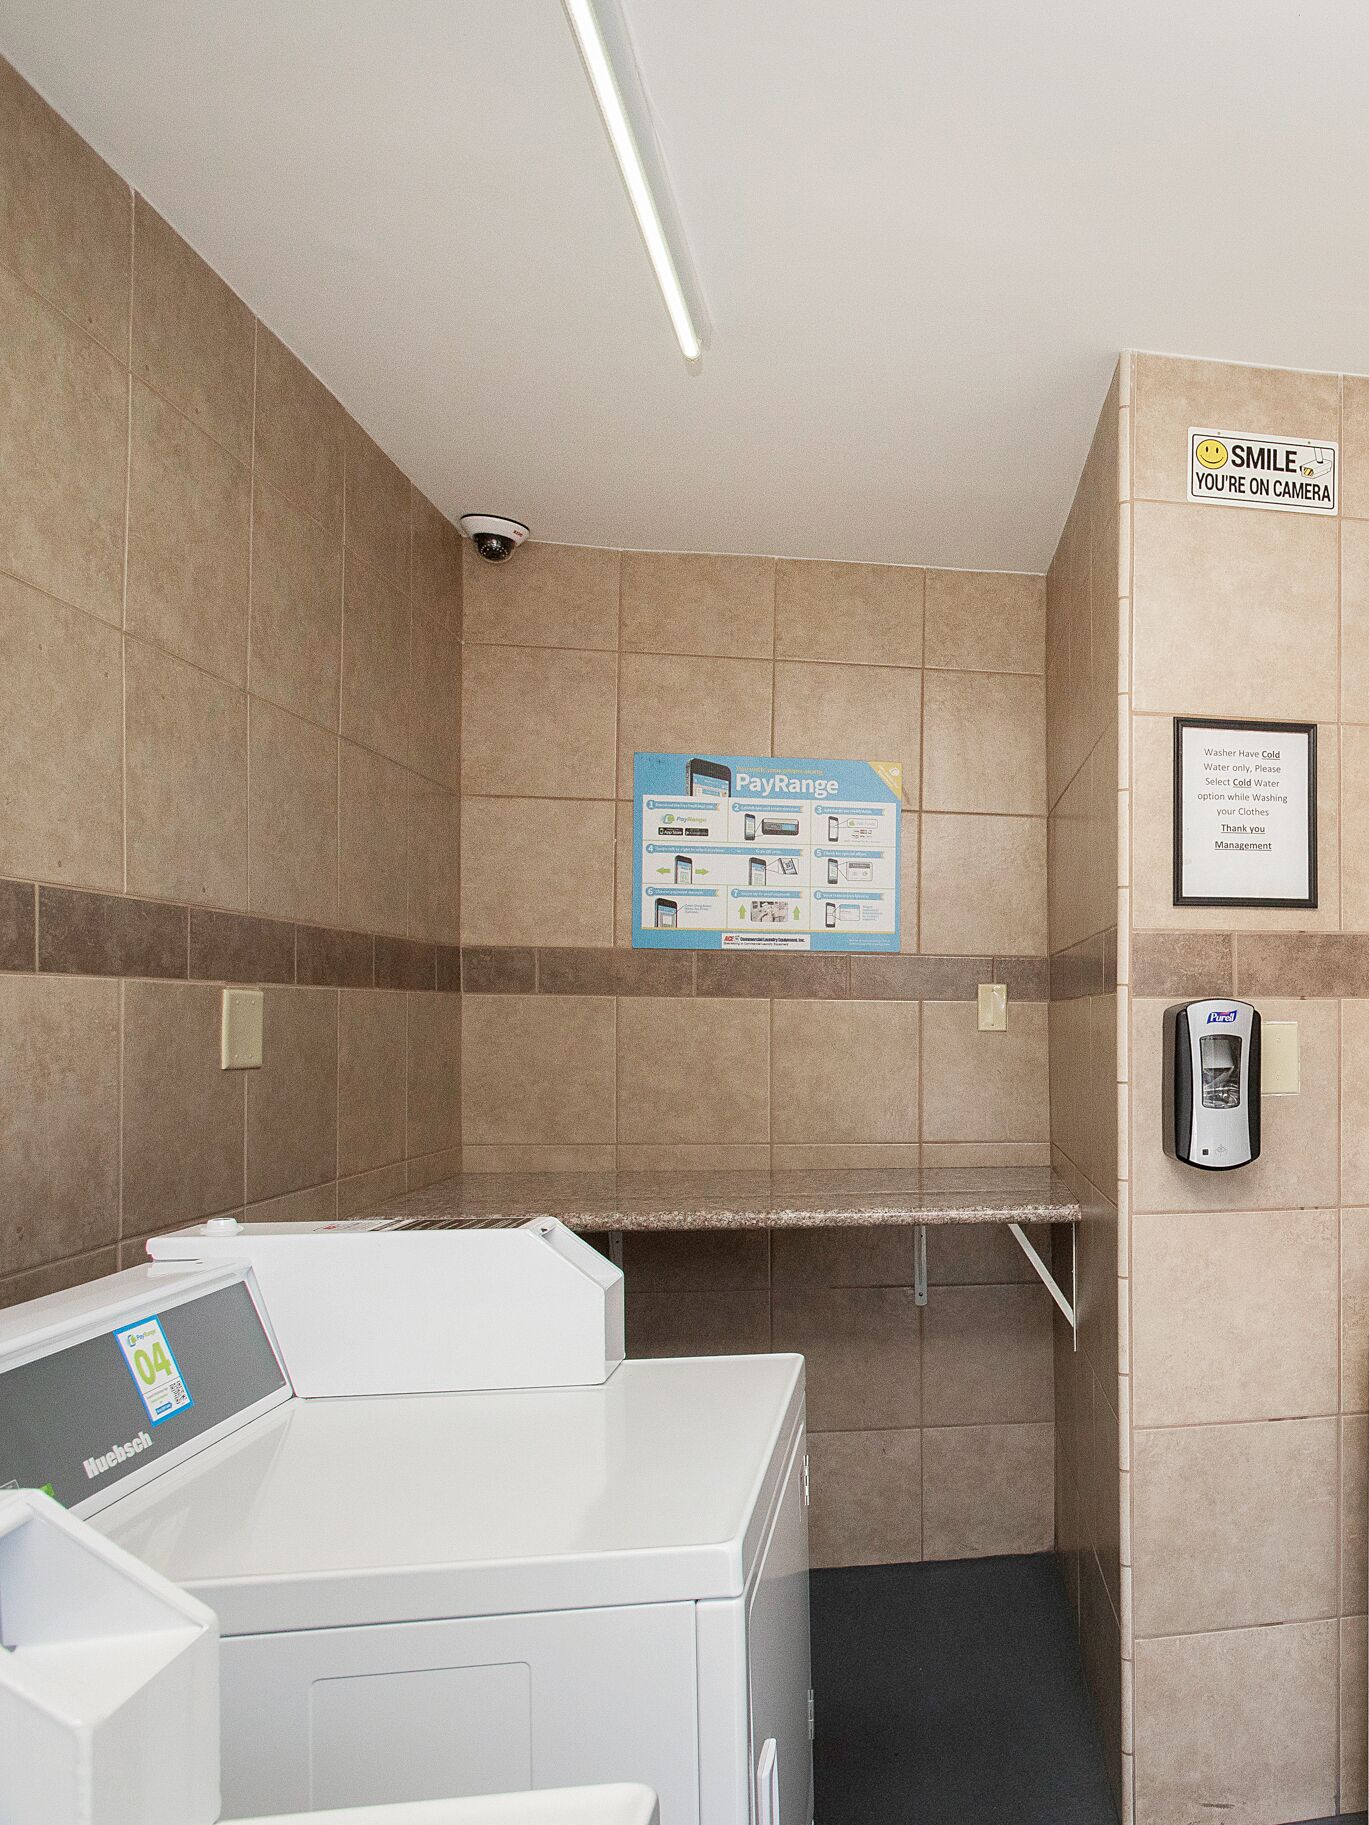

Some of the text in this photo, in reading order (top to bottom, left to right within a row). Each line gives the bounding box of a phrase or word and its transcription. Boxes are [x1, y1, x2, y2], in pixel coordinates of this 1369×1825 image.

[1231, 445, 1297, 473] SMILE
[1196, 472, 1331, 502] YOU'RE ON CAMERA
[1204, 748, 1280, 760] Washer Have Cold
[1204, 763, 1281, 773] Water only, Please
[736, 774, 838, 798] PayRange
[1205, 778, 1230, 786] Select
[1233, 779, 1251, 788] Cold
[1198, 793, 1225, 802] option
[1252, 794, 1288, 803] Washing
[1217, 808, 1269, 816] your Clothes
[1221, 824, 1265, 834] Thank you
[1215, 841, 1272, 851] Management
[134, 1342, 172, 1385] 04
[83, 1430, 153, 1479] Huebsch
